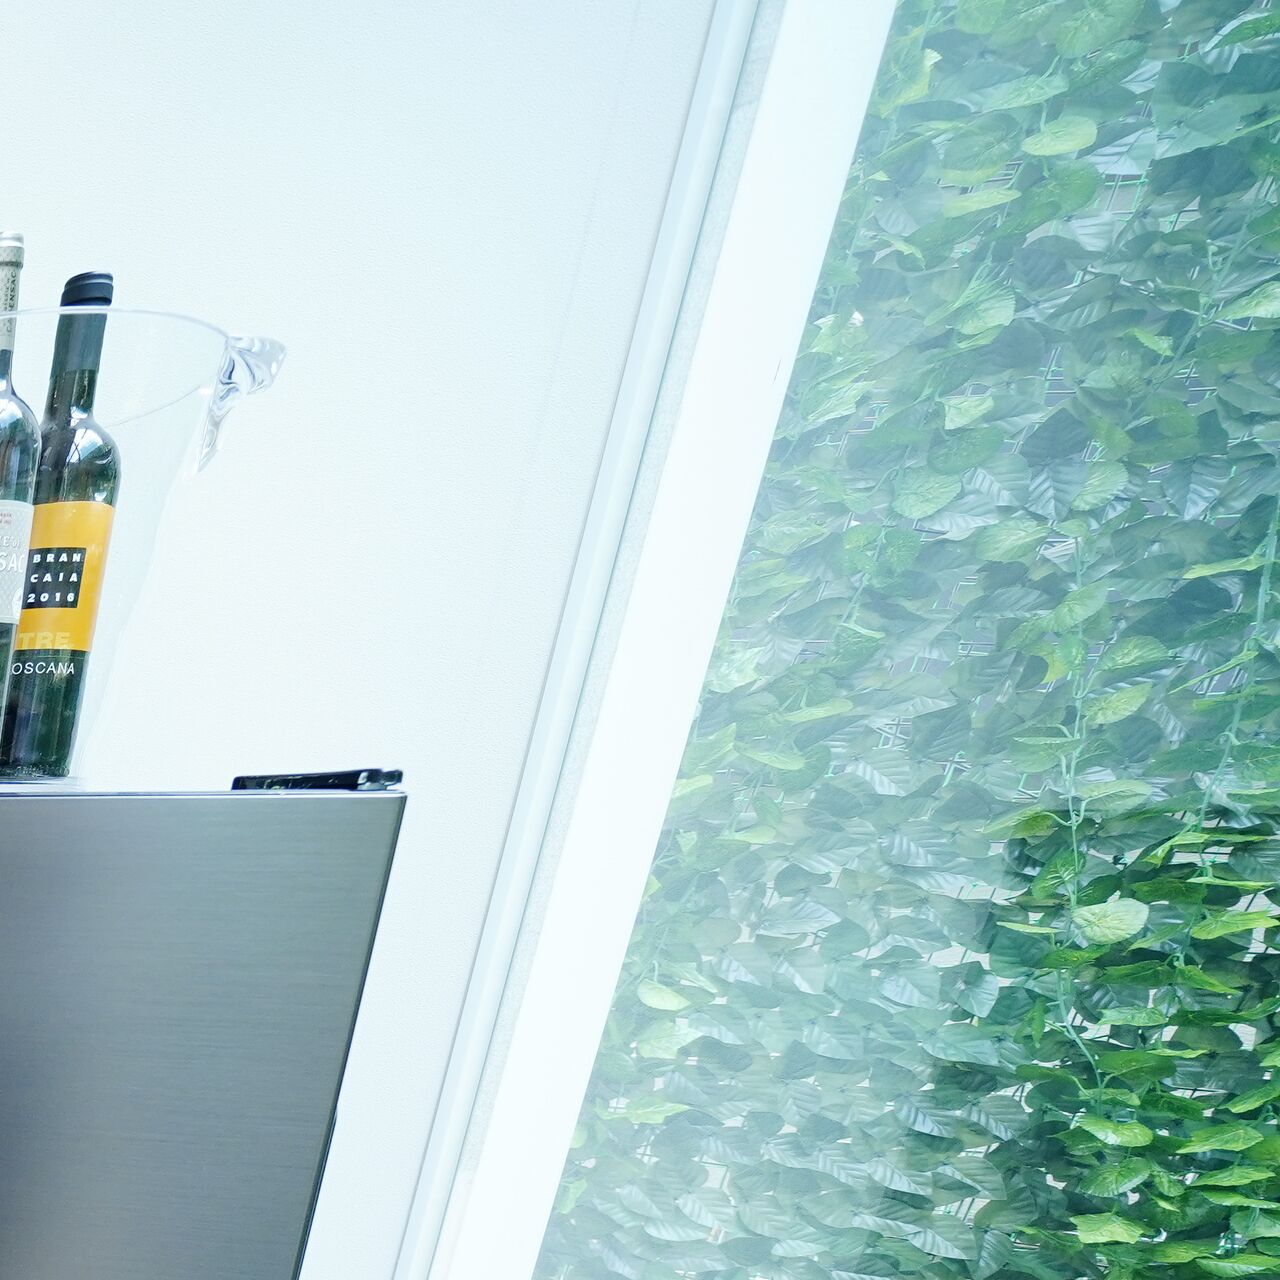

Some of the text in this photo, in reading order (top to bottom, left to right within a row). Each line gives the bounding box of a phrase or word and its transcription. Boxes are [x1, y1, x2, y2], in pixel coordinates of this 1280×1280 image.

[6, 271, 17, 333] CAENSAC
[32, 553, 82, 563] BRAN
[30, 572, 78, 583] CAIA
[27, 592, 75, 603] 2016
[18, 631, 71, 650] TRE
[11, 661, 75, 675] OSCANA
